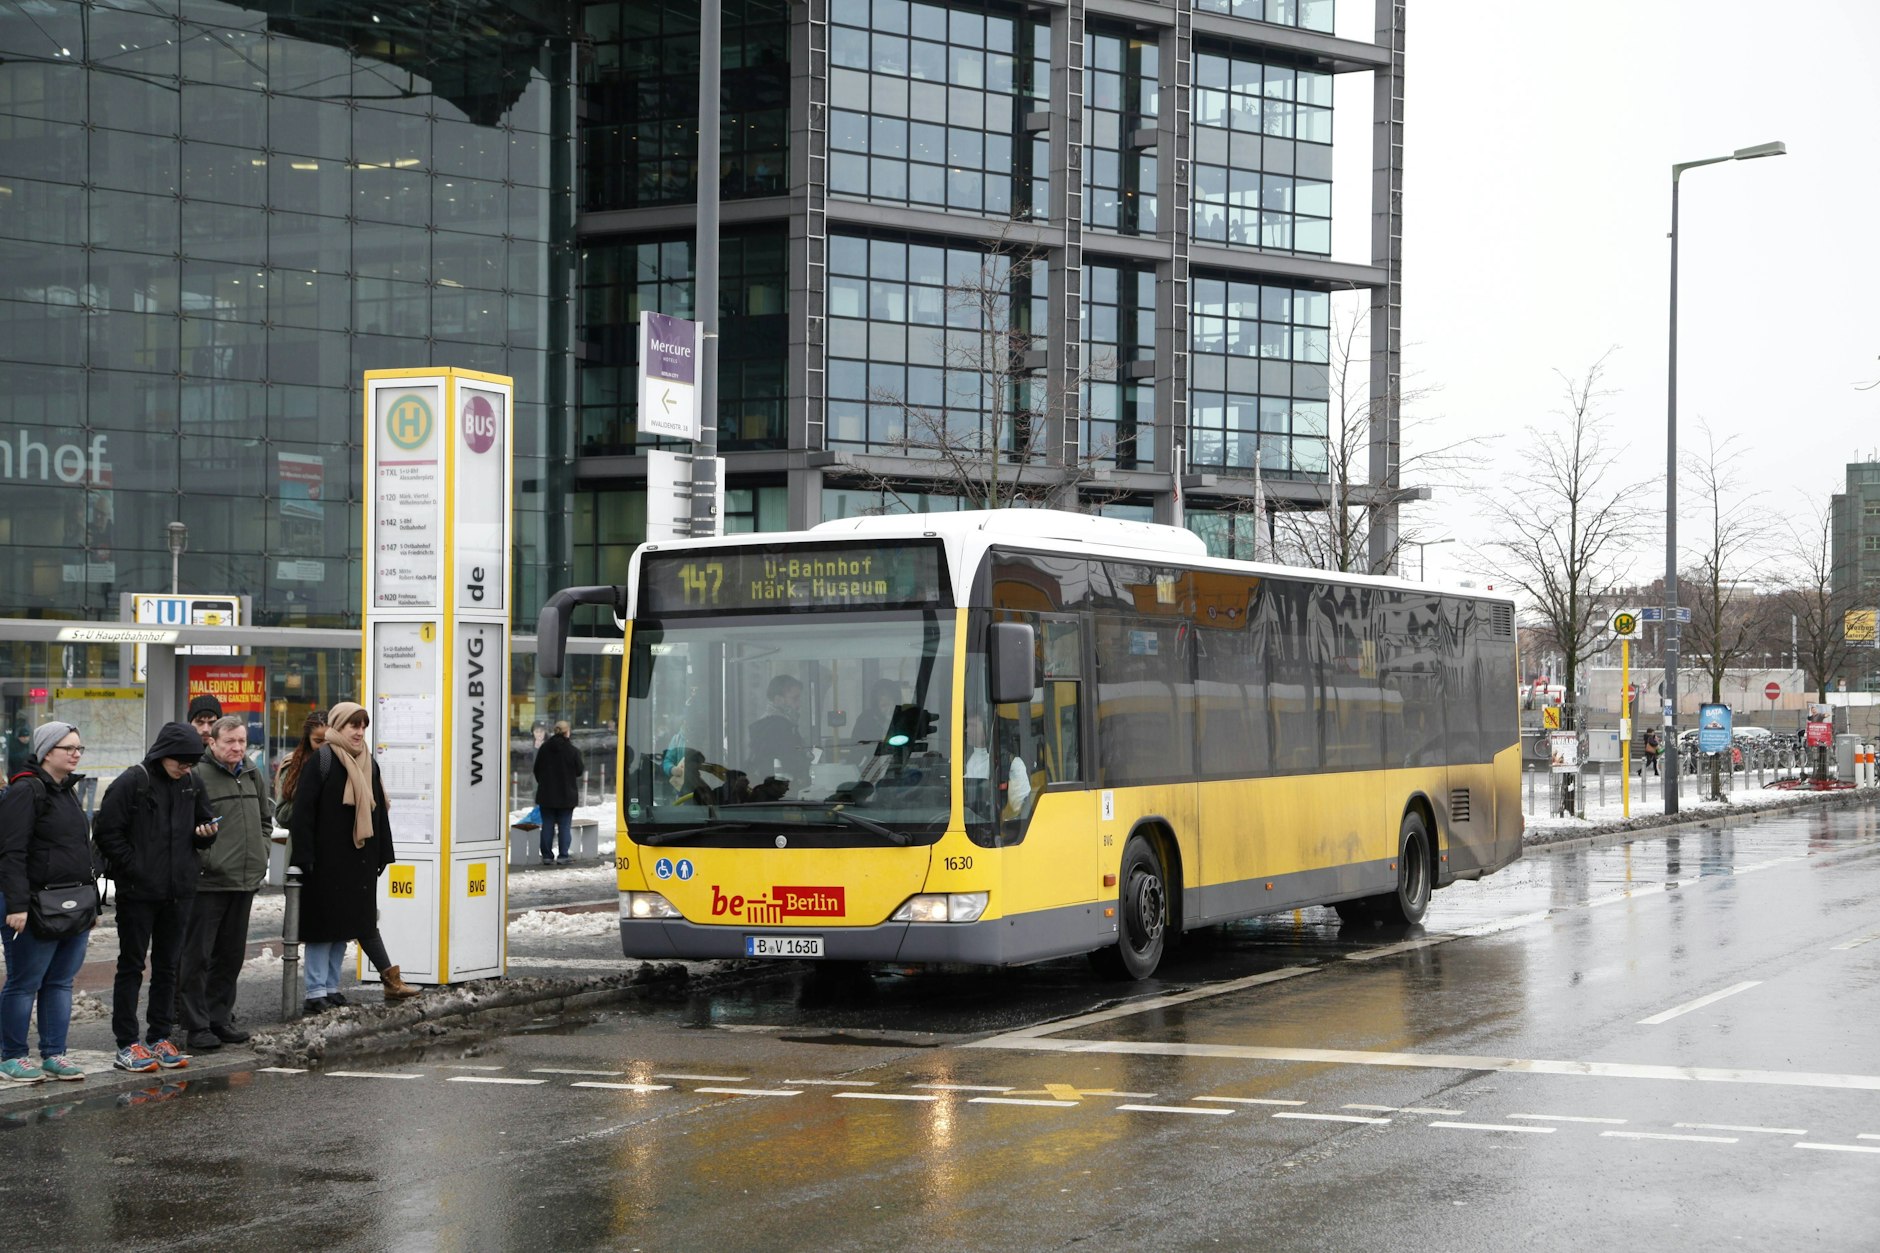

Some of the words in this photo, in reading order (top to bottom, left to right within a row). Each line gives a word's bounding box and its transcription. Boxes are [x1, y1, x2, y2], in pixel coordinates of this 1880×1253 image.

[650, 338, 691, 358] Mercure
[400, 408, 420, 438] H
[465, 413, 494, 438] BUS
[678, 562, 723, 605] 147
[764, 556, 872, 579] U-Bahnhof
[752, 580, 804, 600] Märk.
[812, 578, 888, 597] Museum
[72, 630, 94, 639] S+U
[95, 632, 165, 642] Hauptbahnhof
[425, 626, 429, 638] 1
[84, 688, 115, 697] Information
[190, 680, 239, 693] MALEDIVEN
[242, 681, 254, 693] UM
[257, 681, 263, 693] 7
[228, 694, 249, 703] GANZEN
[1104, 834, 1112, 846] BVG
[614, 857, 629, 870] 30
[944, 856, 973, 871] 1630
[392, 881, 412, 894] BVG
[469, 880, 484, 892] BVG
[712, 886, 744, 916] be
[786, 893, 838, 911] Berlin
[758, 940, 766, 953] B
[776, 940, 783, 953] V
[787, 940, 818, 954] 1630
